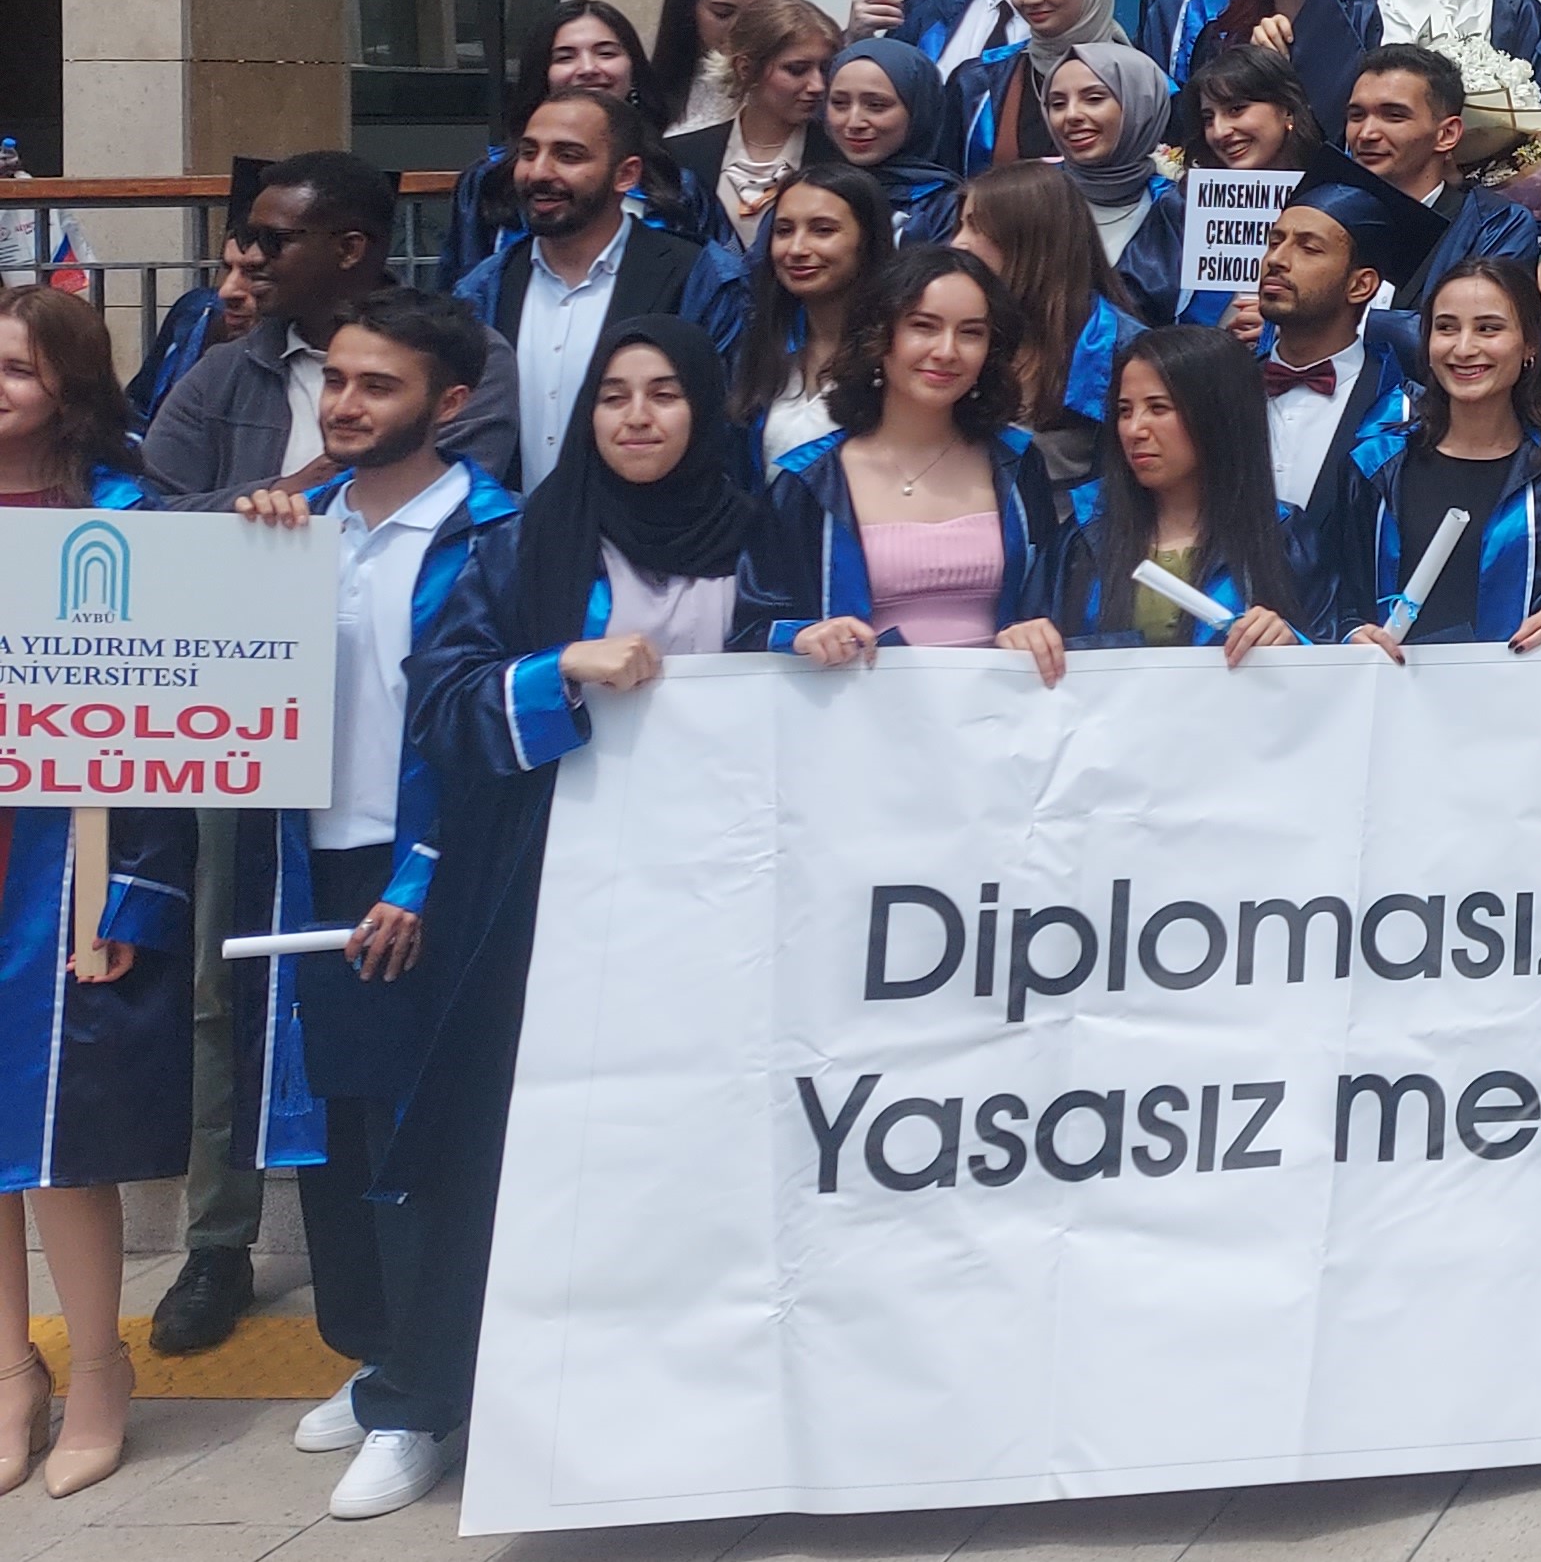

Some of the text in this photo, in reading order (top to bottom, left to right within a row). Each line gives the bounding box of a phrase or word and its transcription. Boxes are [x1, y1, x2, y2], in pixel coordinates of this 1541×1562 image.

[1197, 179, 1271, 209] KİMSENİN
[1197, 251, 1260, 282] PSİKOLO
[72, 611, 116, 624] AYBÜ
[21, 636, 165, 657] YILDIRIM
[173, 639, 299, 660] BEYAZIT
[0, 660, 199, 687] NİVERSİTESİ
[0, 693, 299, 741] İKOLOJİ
[0, 748, 262, 795] ÖLÜMÜ
[794, 1073, 1287, 1195] Yasasız
